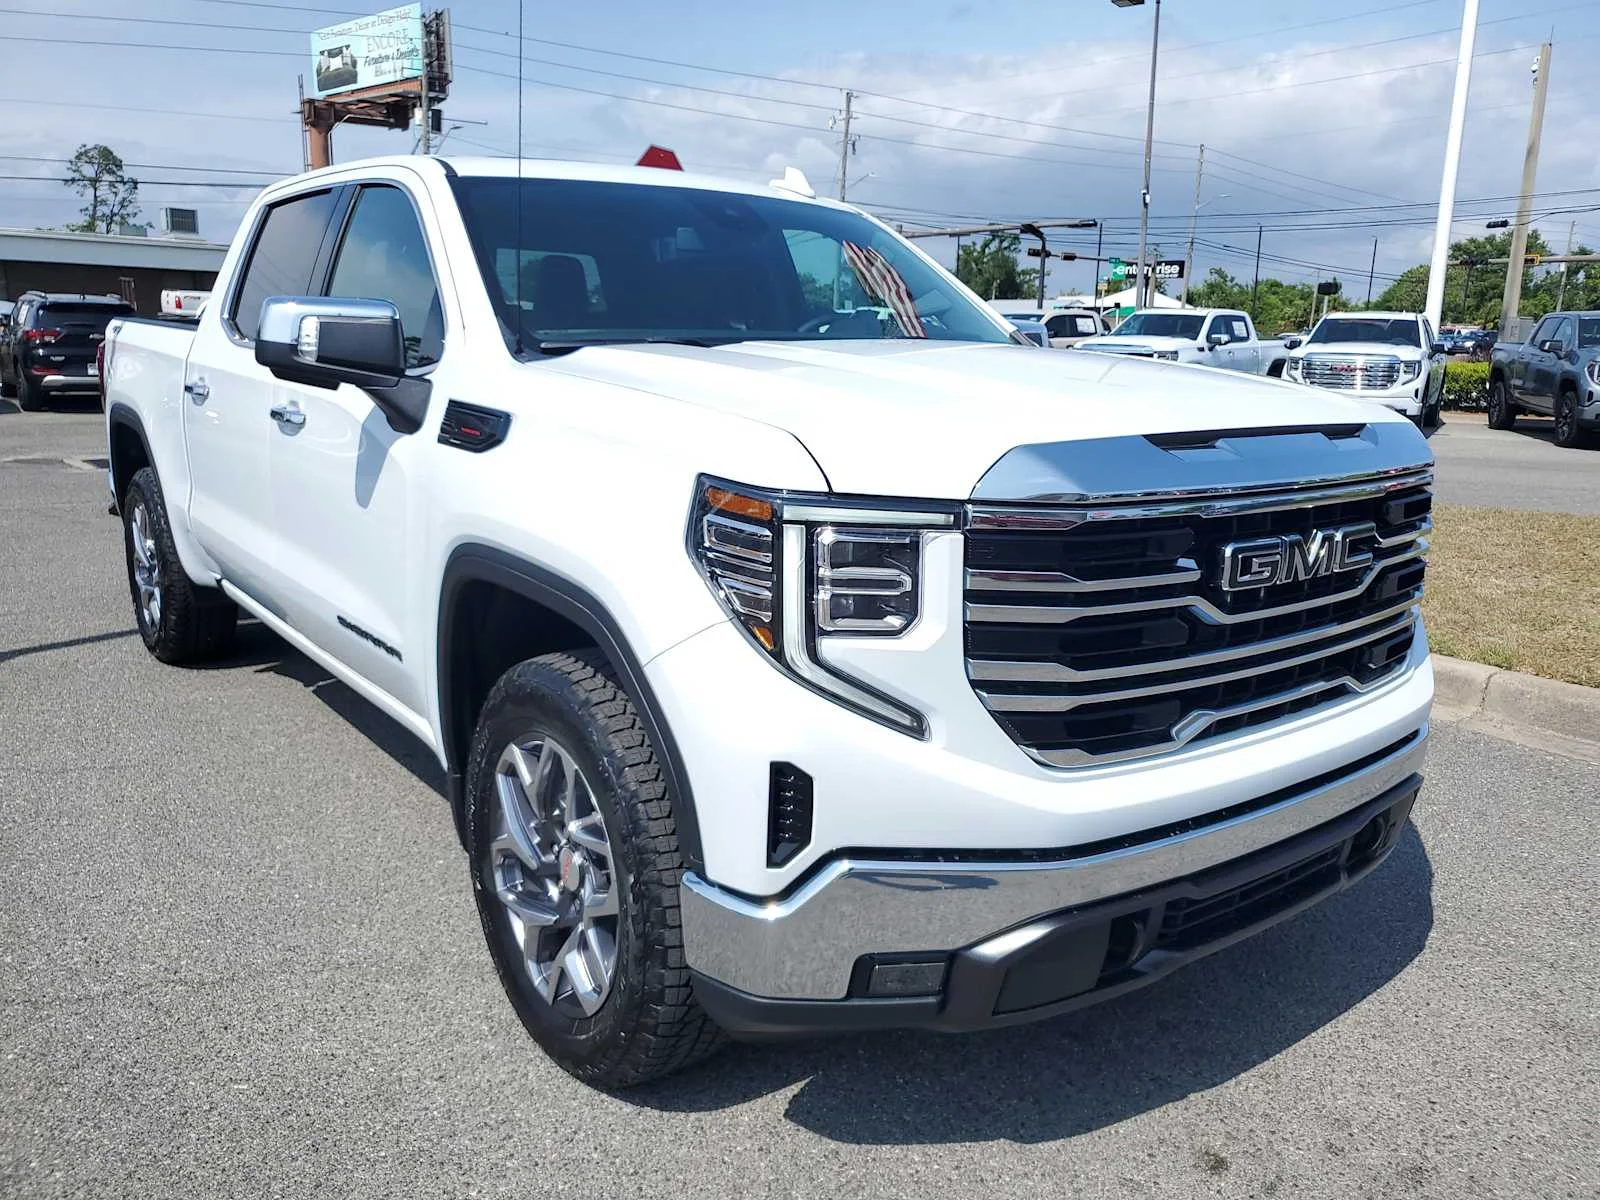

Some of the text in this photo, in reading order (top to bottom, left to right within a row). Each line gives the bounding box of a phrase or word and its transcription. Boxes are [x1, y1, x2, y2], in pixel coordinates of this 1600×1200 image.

[367, 28, 409, 52] ENCORE
[1113, 262, 1180, 277] entrrise
[1222, 520, 1377, 591] GMC
